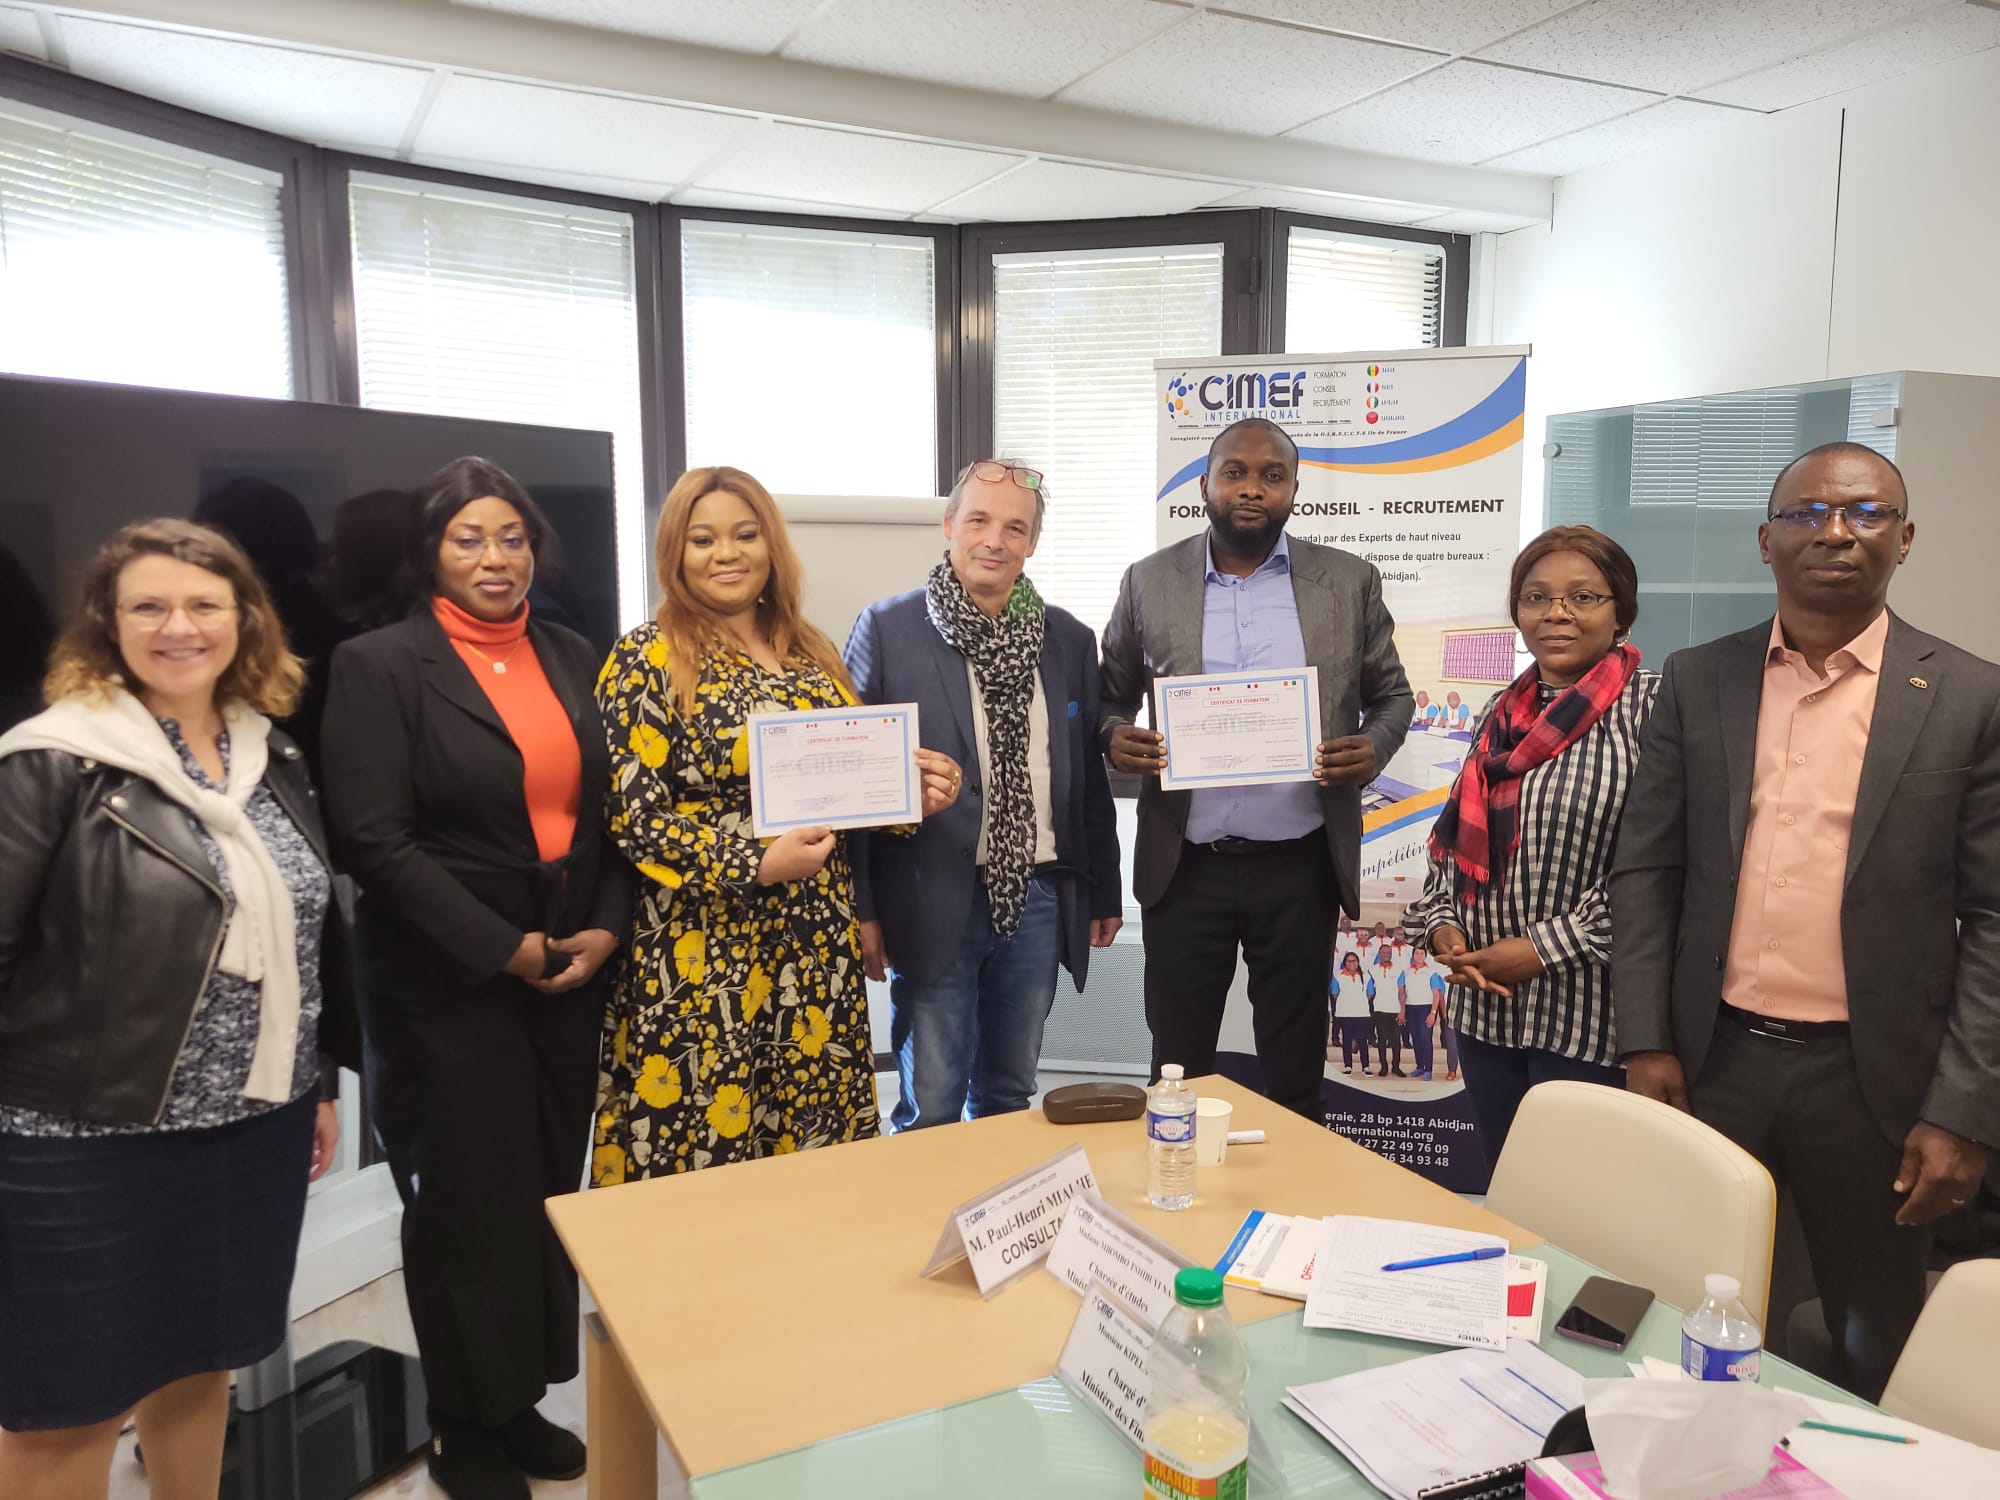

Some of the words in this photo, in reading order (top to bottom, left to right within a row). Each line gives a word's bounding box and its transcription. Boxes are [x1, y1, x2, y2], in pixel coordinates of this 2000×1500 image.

[1313, 371, 1347, 379] FORMATION
[1199, 371, 1307, 411] CIMEF
[1313, 386, 1337, 394] CONSEIL
[1312, 398, 1351, 407] RECRUTEMENT
[1205, 409, 1300, 422] INTERNATIONAL
[1292, 502, 1360, 516] CONSEIL
[1383, 499, 1505, 514] RECRUTEMENT
[1324, 535, 1337, 546] par
[1341, 534, 1356, 542] des
[1359, 532, 1393, 543] Experts
[1396, 532, 1406, 541] de
[1409, 532, 1429, 541] haut
[1431, 532, 1461, 541] niveau
[1365, 552, 1400, 563] dispose
[1402, 552, 1413, 561] de
[1416, 552, 1445, 563] quatre
[1447, 551, 1484, 560] bureaux
[1325, 1112, 1357, 1124] eraie,
[1360, 1113, 1374, 1124] 28
[1378, 1114, 1393, 1126] bp
[1396, 1115, 1425, 1127] 1418
[1428, 1118, 1474, 1132] Abidjan
[1364, 1138, 1378, 1149] 27
[1382, 1140, 1396, 1150] 22
[1399, 1141, 1413, 1151] 49
[1417, 1142, 1431, 1152] 76
[1434, 1144, 1449, 1154] 09
[1399, 1153, 1414, 1164] 34
[1417, 1155, 1431, 1166] 93
[1434, 1156, 1449, 1167] 48
[969, 1236, 986, 1255] M.
[987, 1200, 1046, 1244] Paul-Henri
[1118, 1283, 1148, 1312] d'études
[1108, 1367, 1136, 1400] Chargé
[1080, 1369, 1114, 1411] Ministère
[1114, 1406, 1127, 1425] des
[1151, 1457, 1198, 1497] ORANGE
